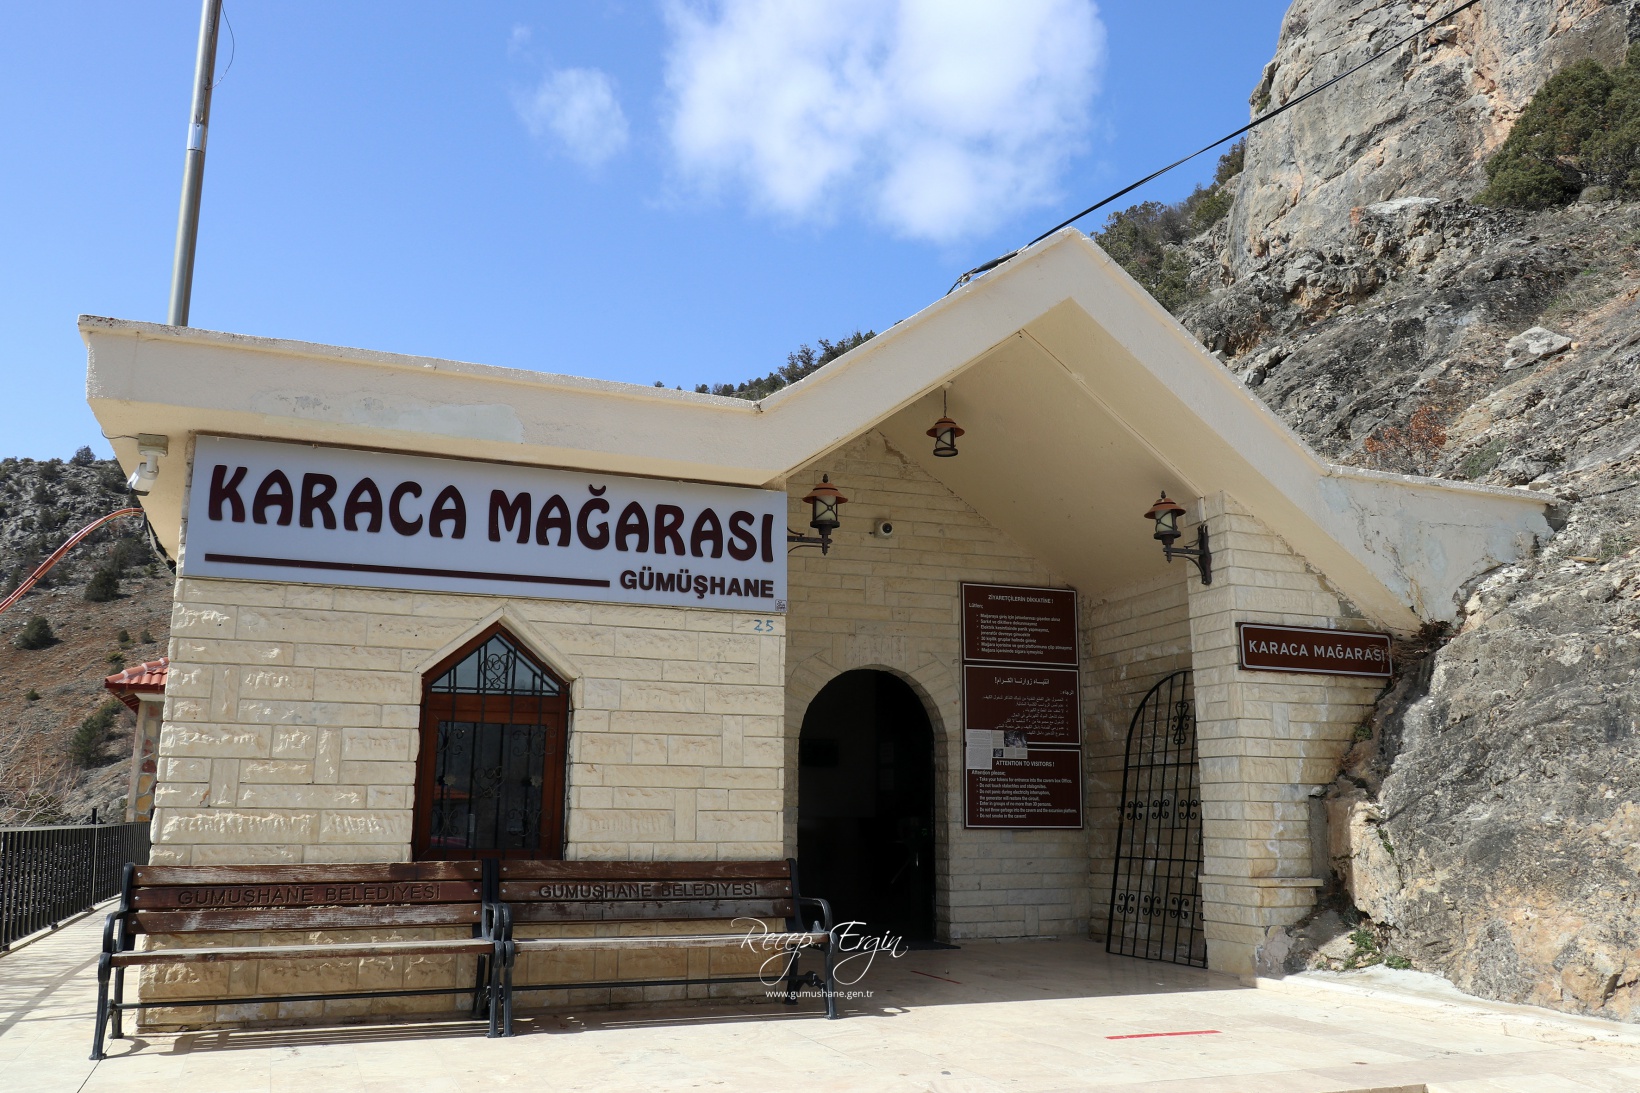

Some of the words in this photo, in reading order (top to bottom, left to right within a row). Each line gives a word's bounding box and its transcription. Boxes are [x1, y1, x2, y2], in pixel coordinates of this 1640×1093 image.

[208, 465, 467, 539] KARACA
[487, 483, 774, 562] MAĞARASI
[620, 566, 774, 598] GÜMÜŞHANE
[753, 619, 774, 632] 25
[1249, 640, 1308, 657] KARACA
[1314, 644, 1385, 662] MAĞARASI
